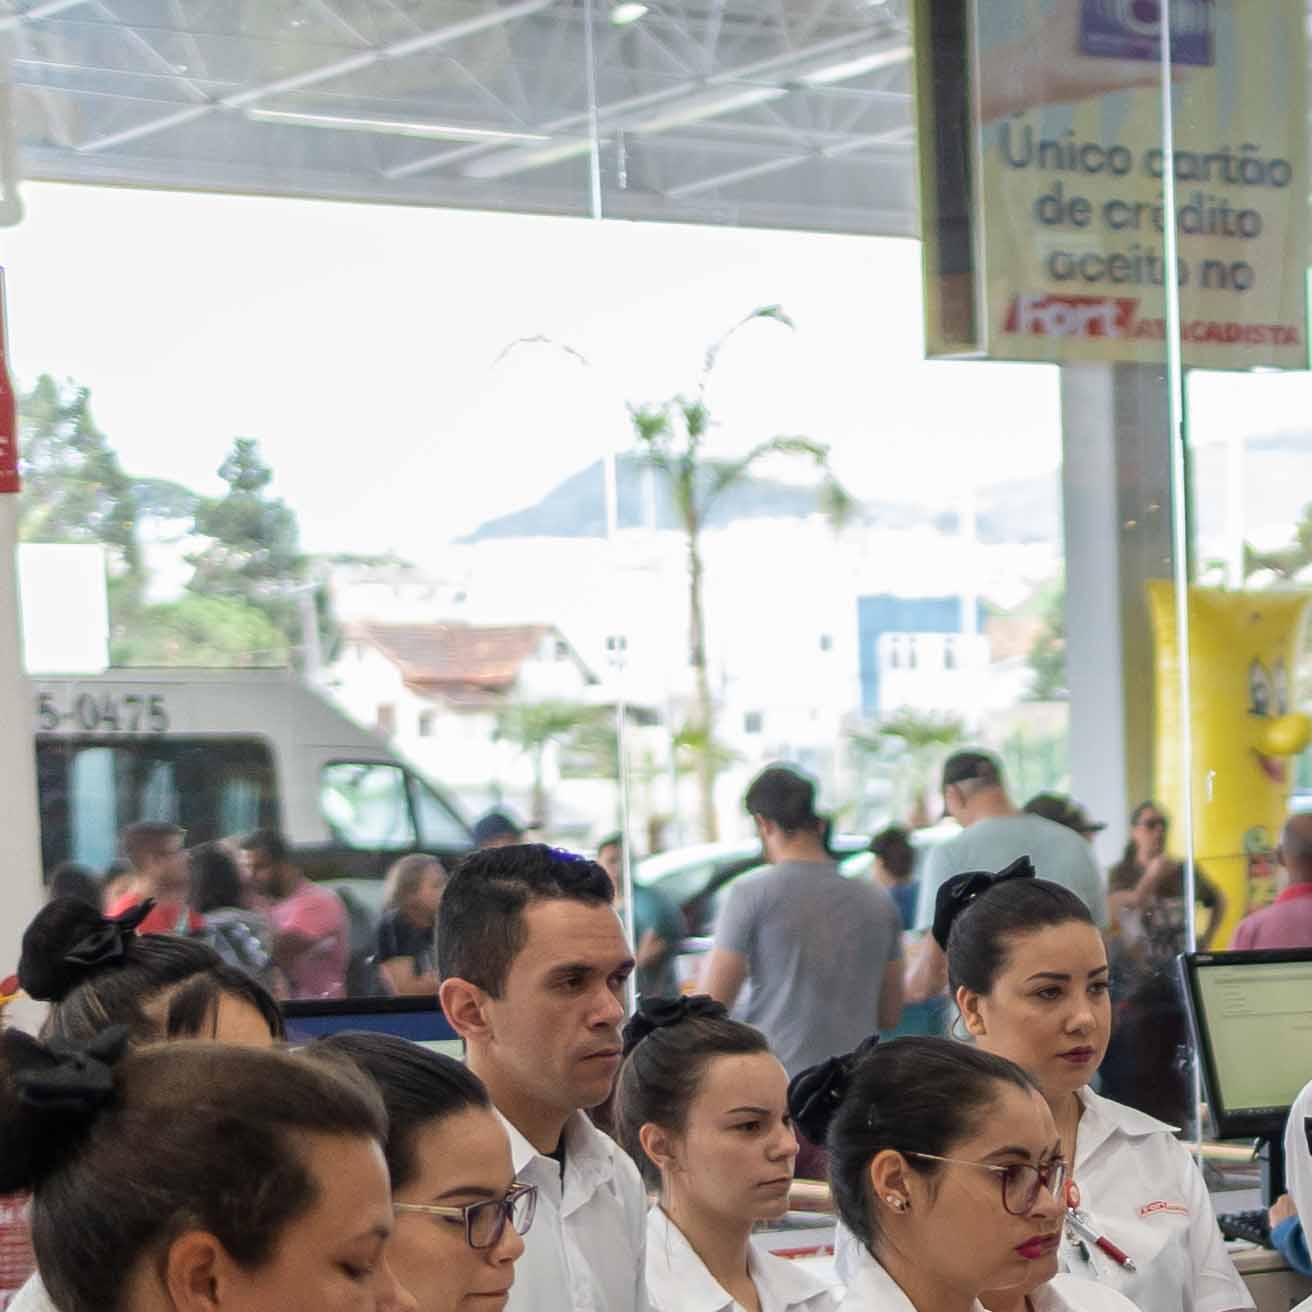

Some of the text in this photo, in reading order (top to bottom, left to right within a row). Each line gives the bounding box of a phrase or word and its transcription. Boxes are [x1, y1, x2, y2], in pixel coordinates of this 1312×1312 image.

[1145, 144, 1292, 187] cartão
[1036, 182, 1093, 228] de
[1047, 243, 1253, 290] aceito no
